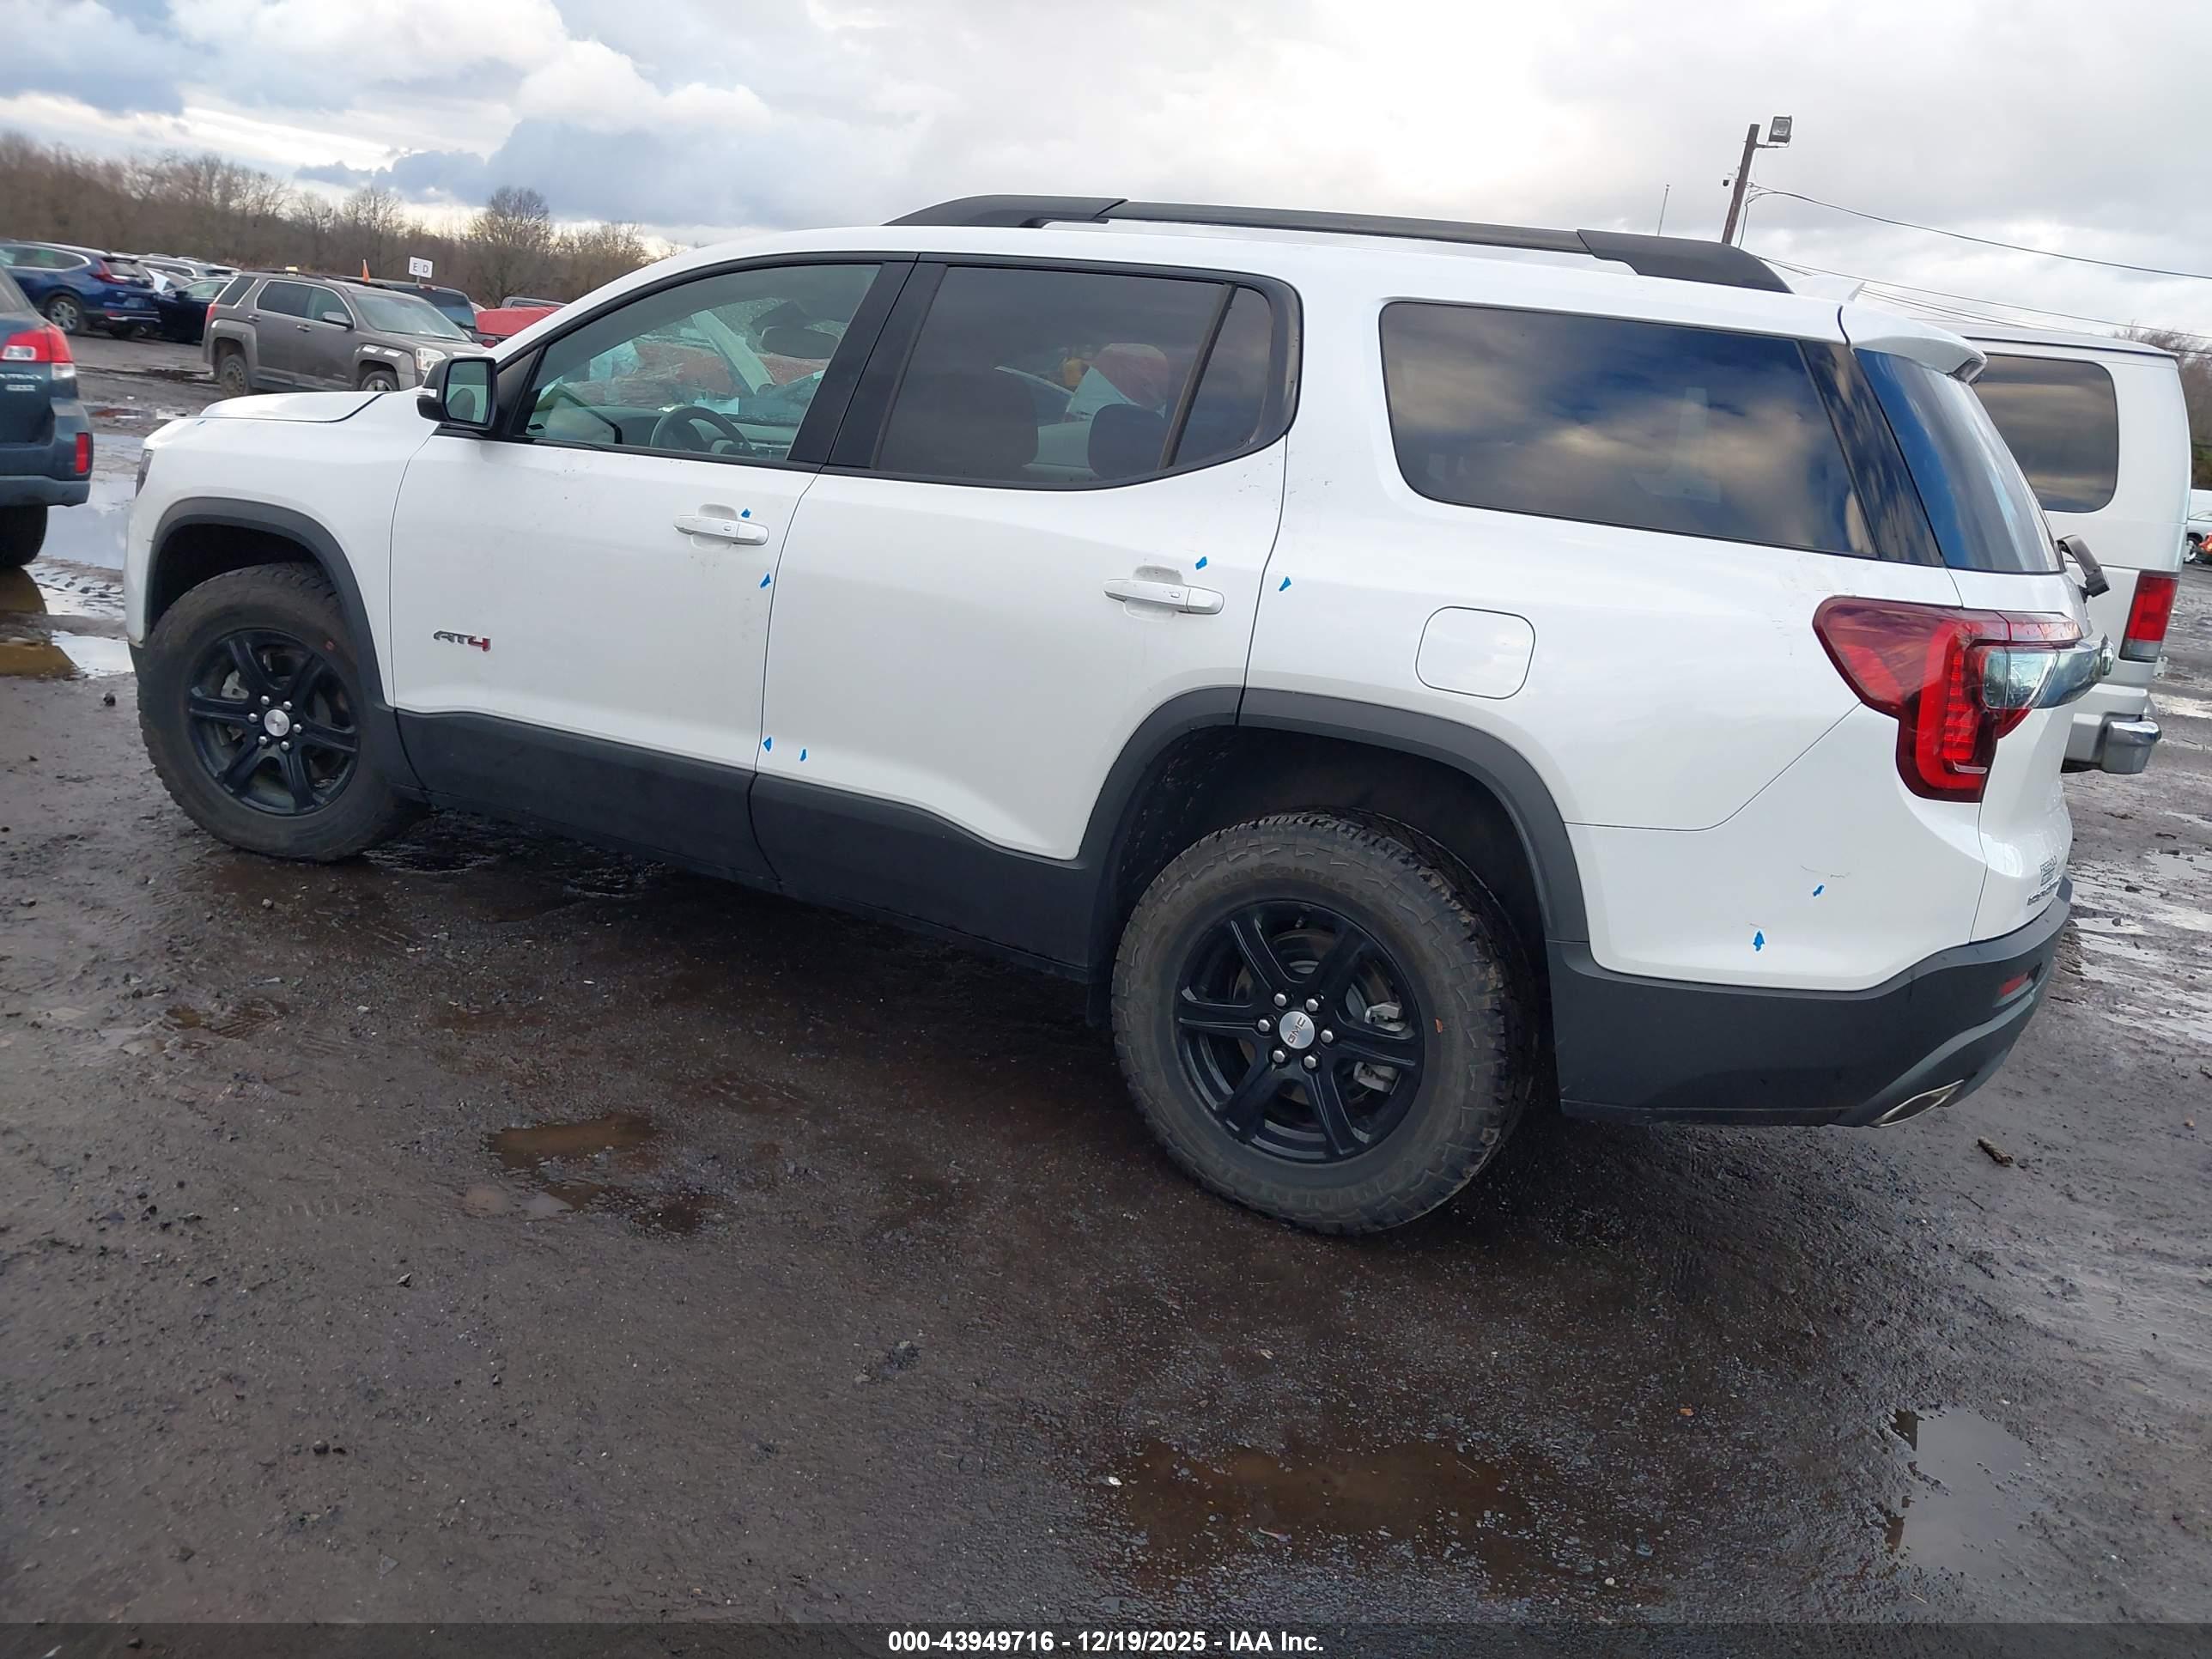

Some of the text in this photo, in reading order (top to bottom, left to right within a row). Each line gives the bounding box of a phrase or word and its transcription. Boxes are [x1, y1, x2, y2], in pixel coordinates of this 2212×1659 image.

[412, 262, 429, 274] E D
[433, 630, 491, 652] AT4
[1287, 1016, 1306, 1044] GMC
